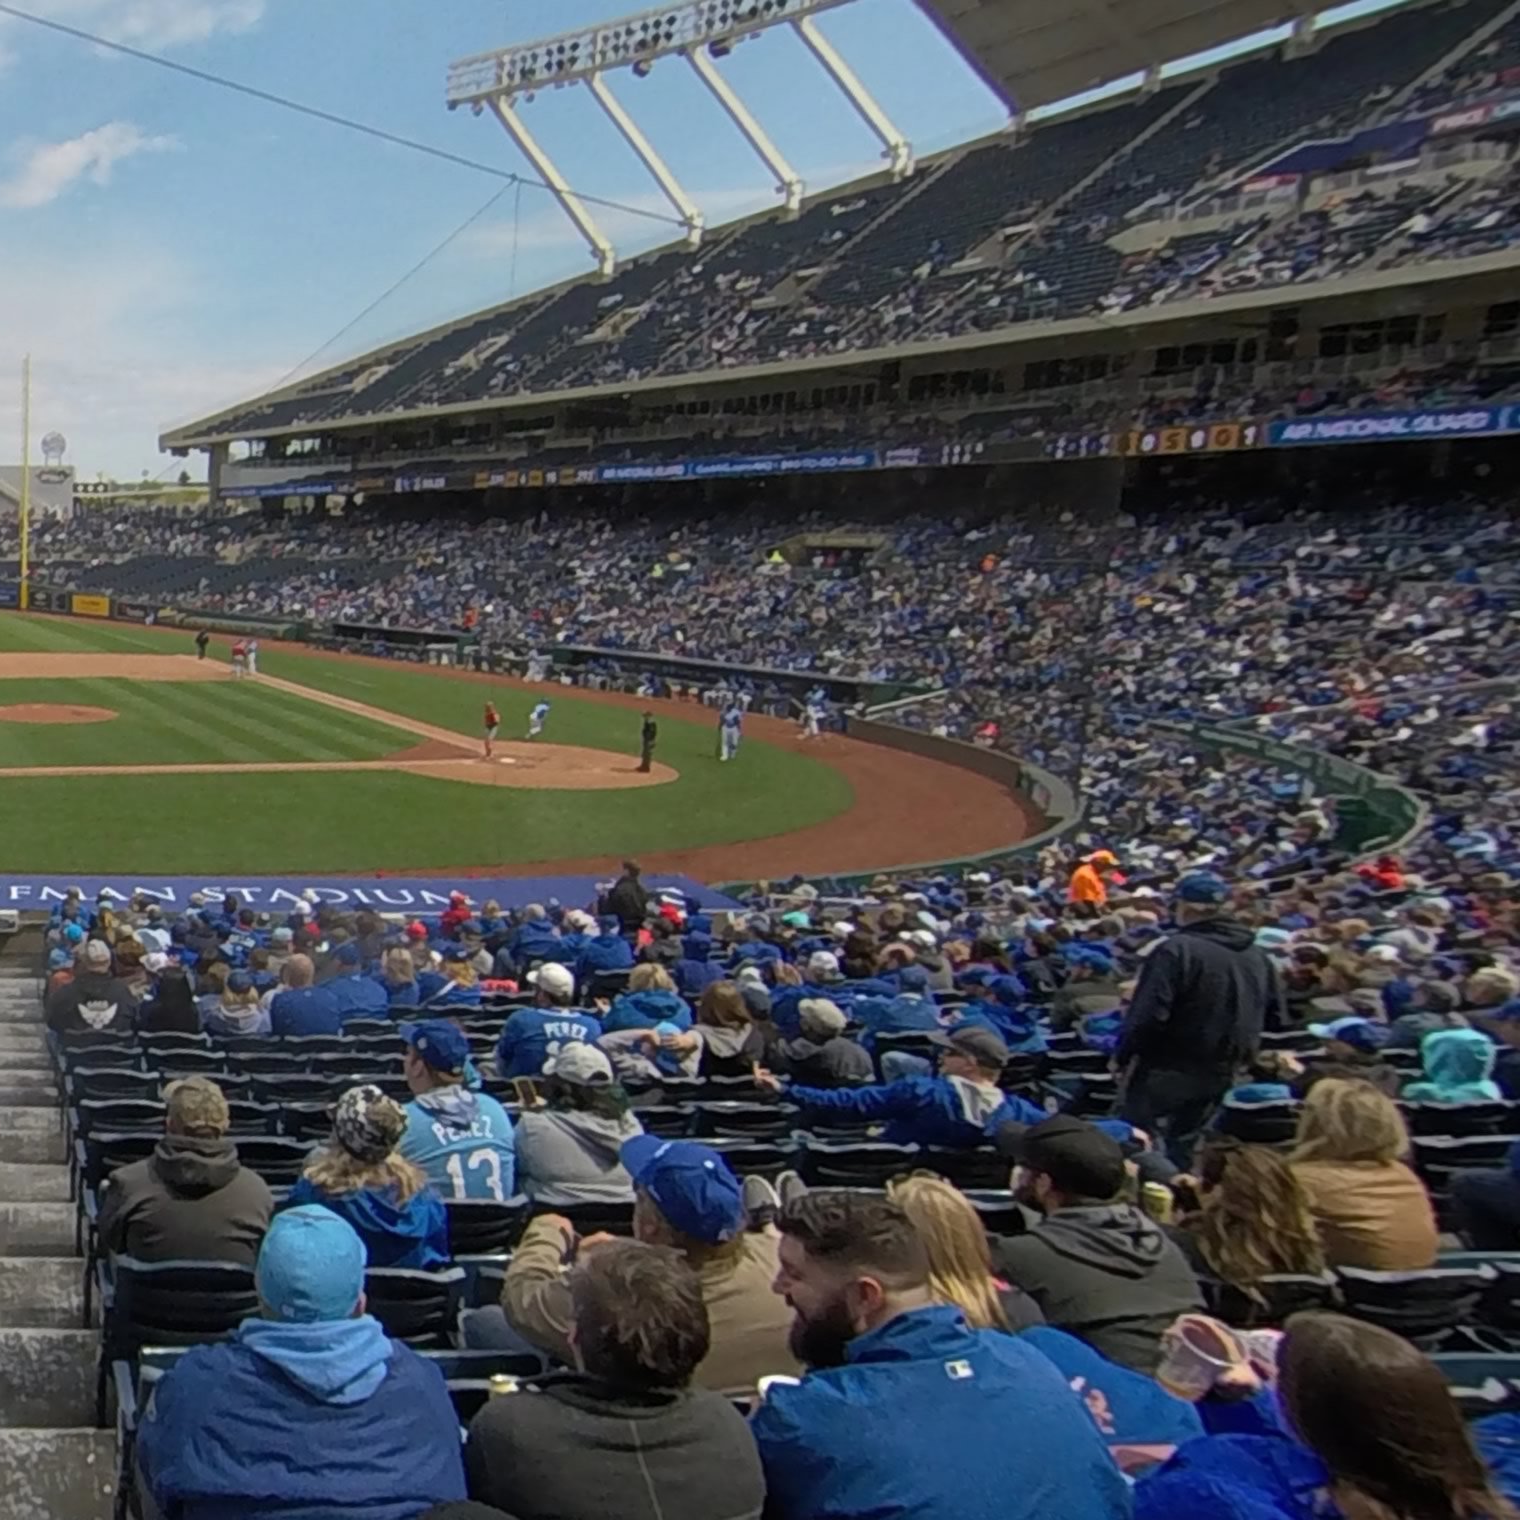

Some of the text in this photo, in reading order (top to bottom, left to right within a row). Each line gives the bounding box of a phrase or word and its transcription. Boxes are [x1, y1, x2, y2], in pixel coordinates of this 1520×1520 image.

[199, 885, 477, 905] STADIUM
[543, 1022, 588, 1041] PEREZ
[446, 1148, 504, 1201] 13
